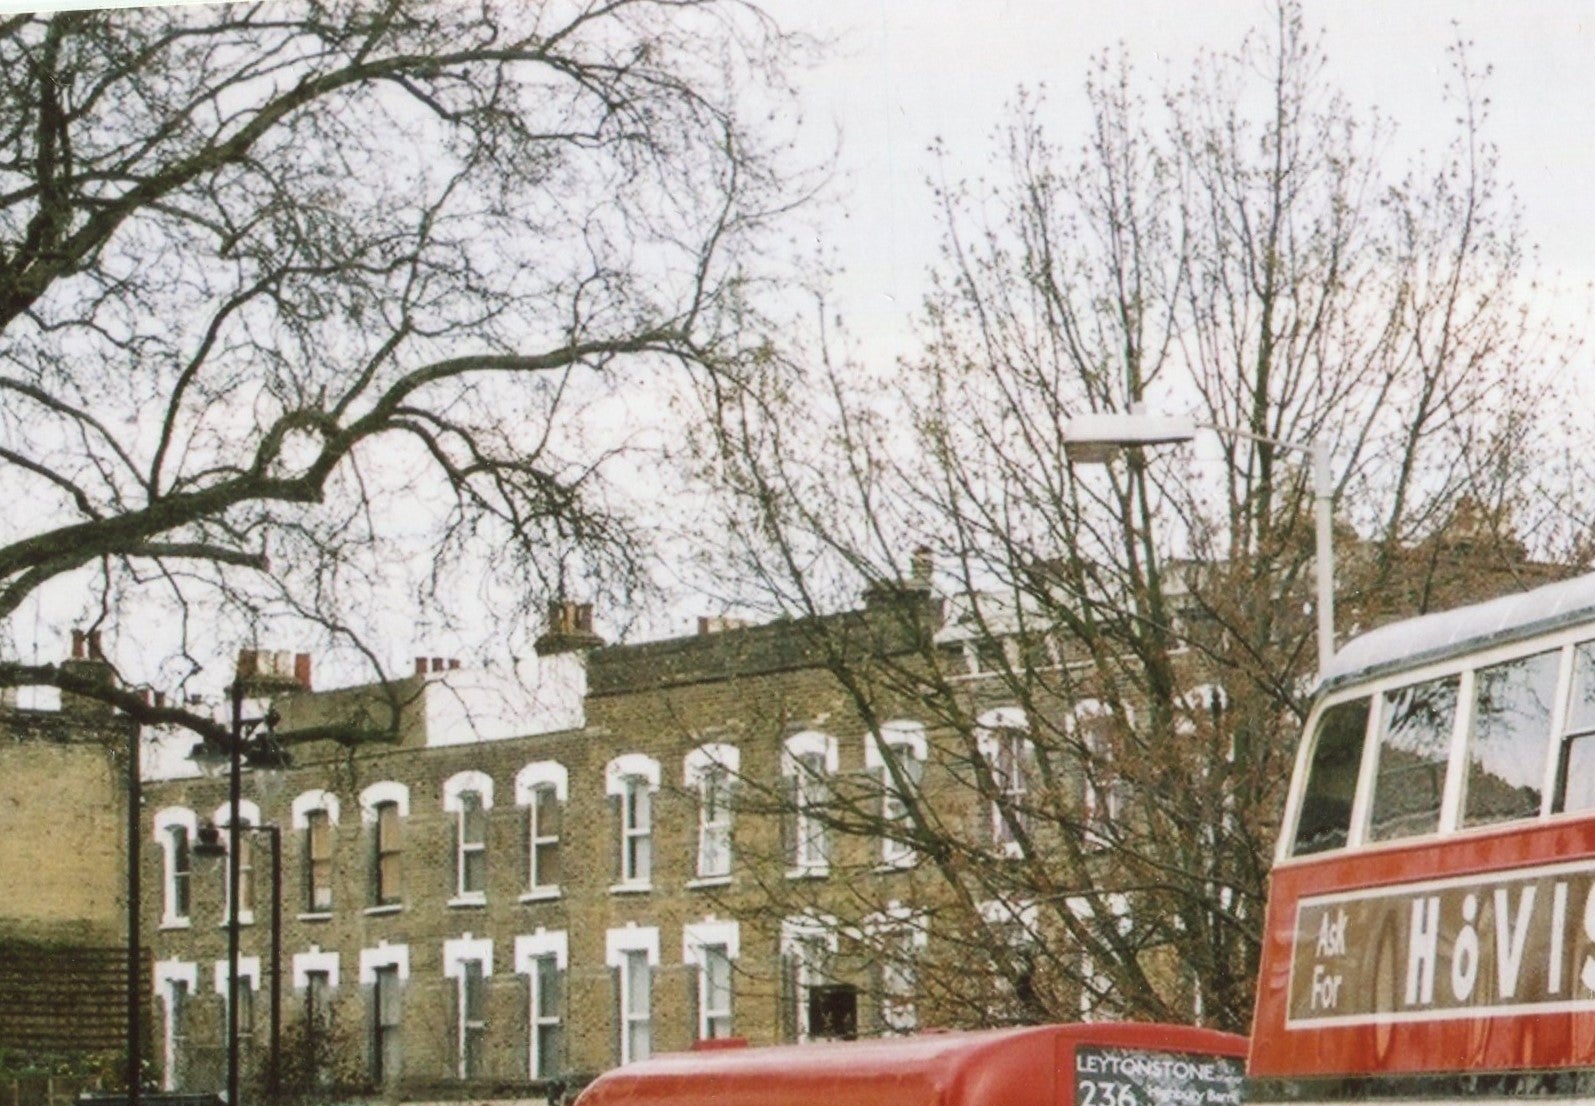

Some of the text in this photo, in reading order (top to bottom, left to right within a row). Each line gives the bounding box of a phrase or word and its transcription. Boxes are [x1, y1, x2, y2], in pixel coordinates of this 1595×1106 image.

[1316, 910, 1348, 957] Ask
[1310, 964, 1342, 1011] For
[1077, 1055, 1214, 1082] LEYTONSTONE
[1147, 1084, 1205, 1104] Highbury
